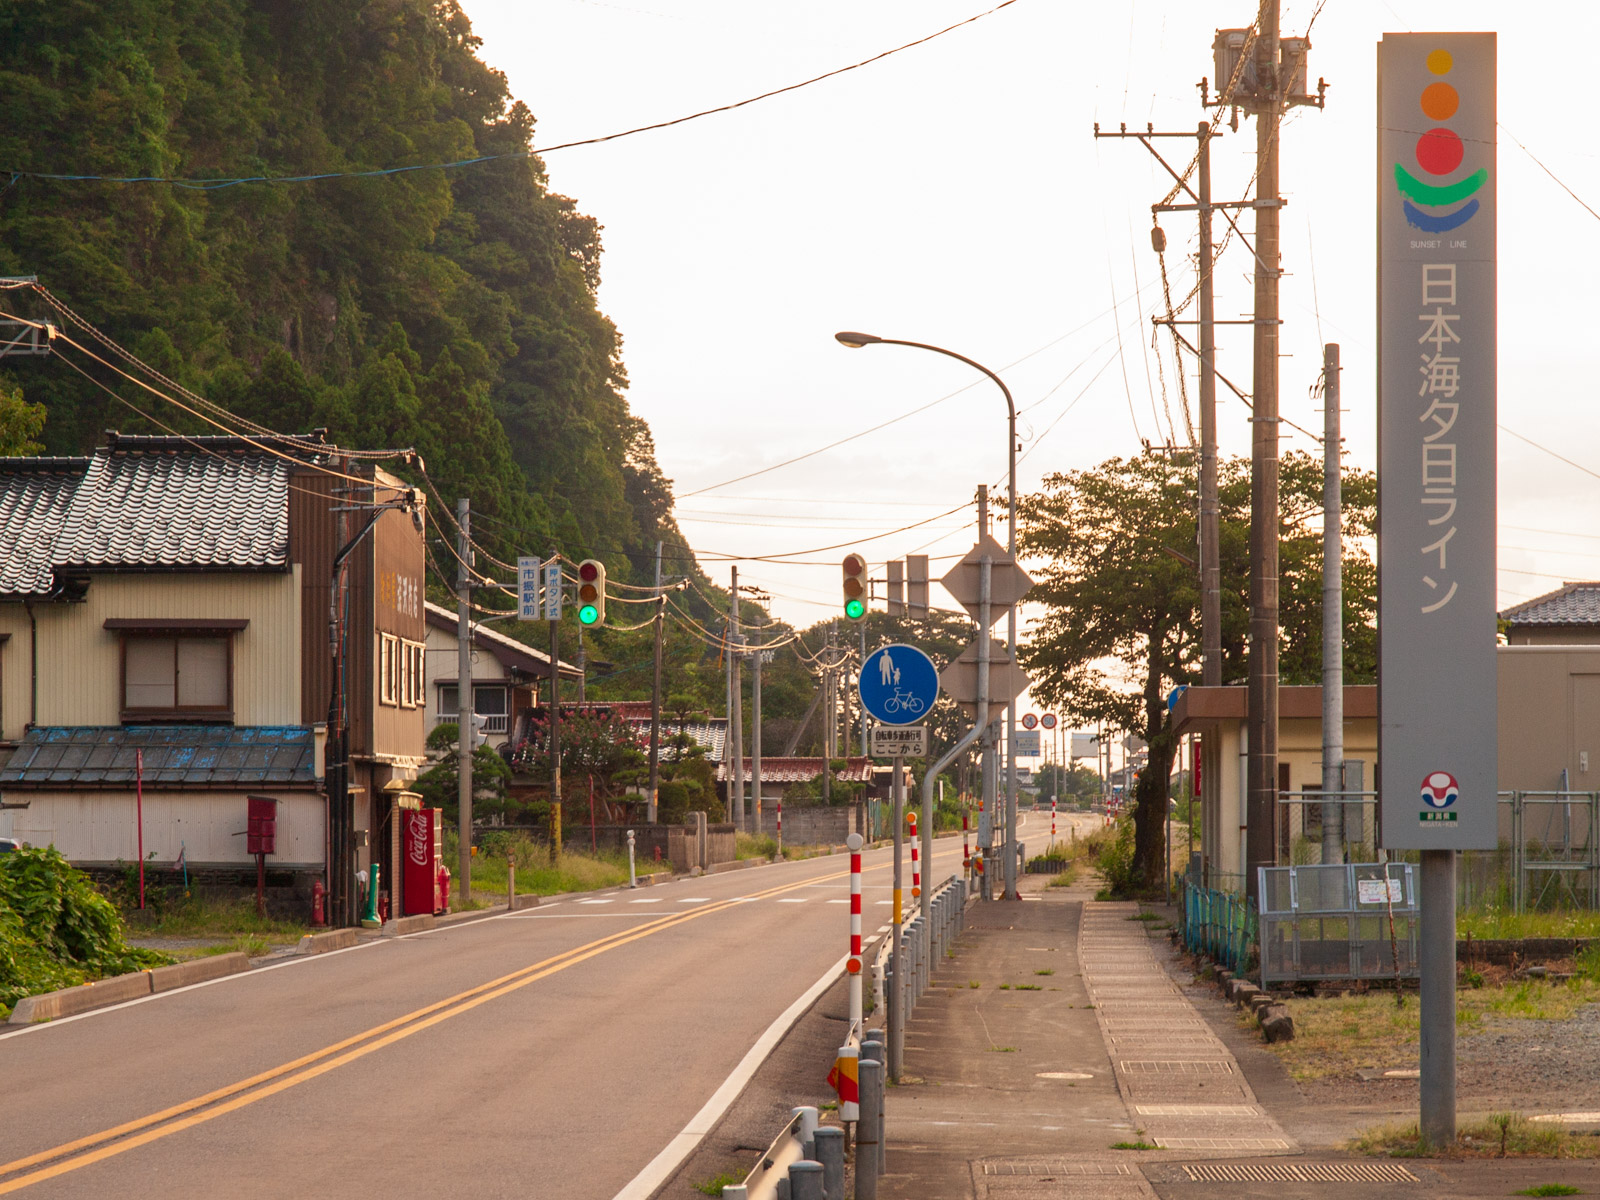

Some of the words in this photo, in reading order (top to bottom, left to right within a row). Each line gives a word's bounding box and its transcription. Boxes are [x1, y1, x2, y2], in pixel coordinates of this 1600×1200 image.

[1410, 240, 1441, 249] SUNSET
[1450, 240, 1467, 249] LINE
[1418, 263, 1461, 614] 日本海夕日ライン
[522, 568, 536, 616] 市振駅前
[549, 568, 558, 617] 押ボタン式
[876, 744, 922, 754] ここから
